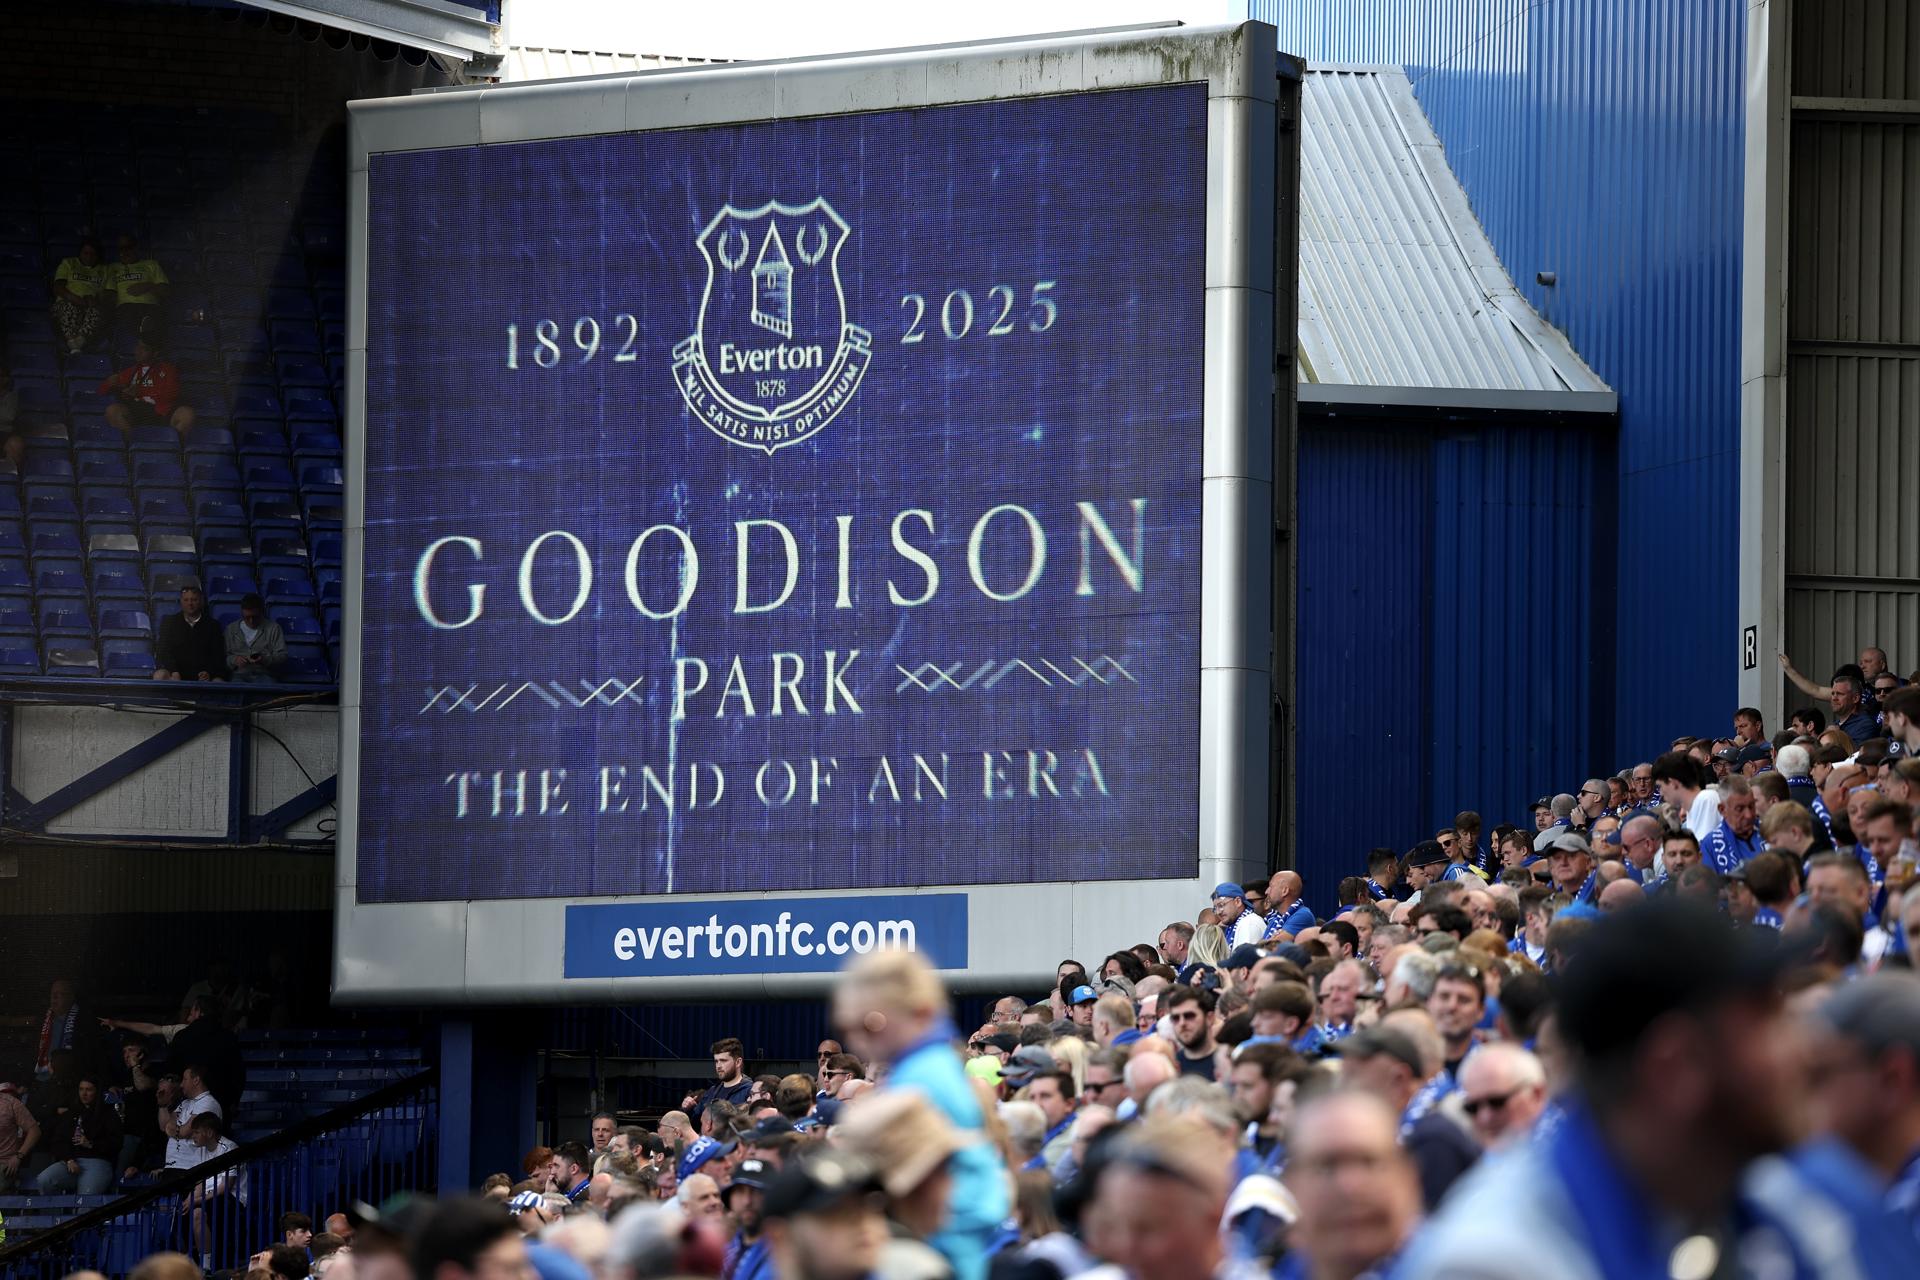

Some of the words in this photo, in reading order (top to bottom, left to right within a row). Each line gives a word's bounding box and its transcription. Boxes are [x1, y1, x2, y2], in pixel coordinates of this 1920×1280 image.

[506, 314, 638, 369] 1892
[901, 281, 1057, 345] 2025
[720, 343, 822, 374] Everton
[684, 376, 704, 406] NIL
[706, 404, 748, 438] SATIS
[753, 422, 789, 440] NISI
[795, 364, 859, 433] OPTIMUM
[756, 379, 786, 398] 1878
[413, 498, 1147, 629] GOODISON
[1745, 629, 1755, 667] R
[675, 649, 863, 720] PARK
[445, 768, 569, 817] THE
[598, 763, 725, 812] END
[755, 757, 839, 806] OF
[868, 752, 949, 804] AN
[982, 748, 1110, 800] ERA
[613, 911, 916, 961] evertonfc.com
